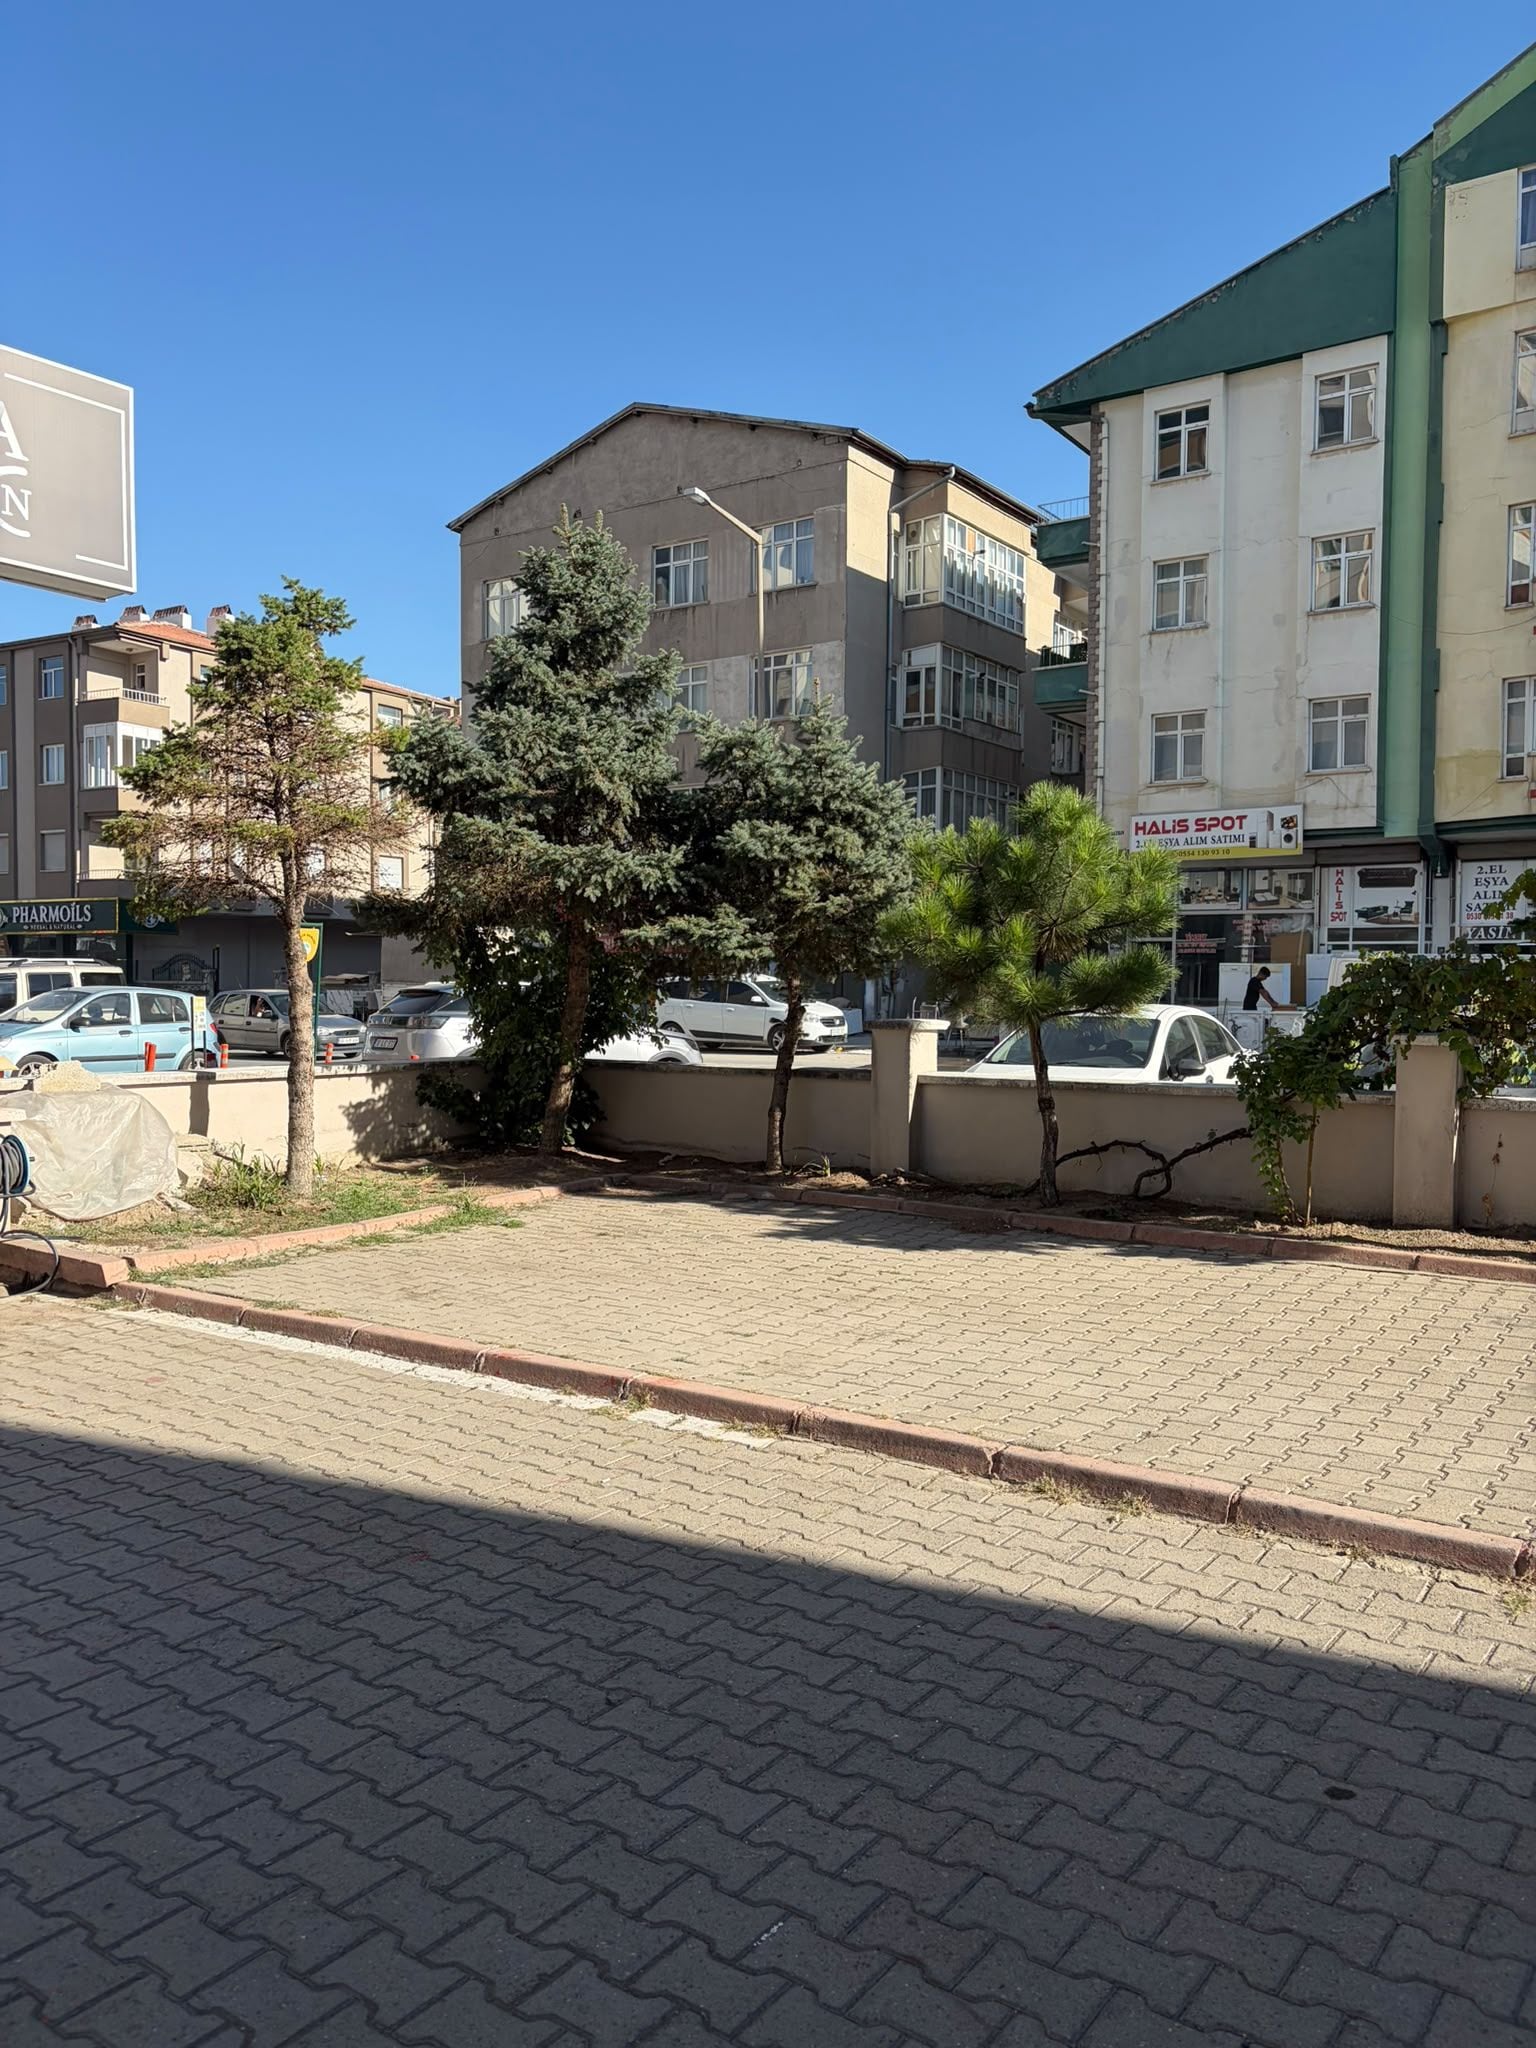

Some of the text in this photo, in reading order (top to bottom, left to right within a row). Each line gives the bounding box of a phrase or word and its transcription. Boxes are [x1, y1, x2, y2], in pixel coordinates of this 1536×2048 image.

[0, 484, 32, 520] N
[1194, 815, 1248, 832] SPOT
[1158, 838, 1180, 848] EŞYA
[1183, 836, 1210, 846] ALIM
[1211, 834, 1245, 845] SATIMI
[1221, 848, 1231, 856] 10
[1477, 865, 1507, 875] 2.EL
[1474, 877, 1509, 888] EŞYA
[1330, 911, 1347, 922] SPOT
